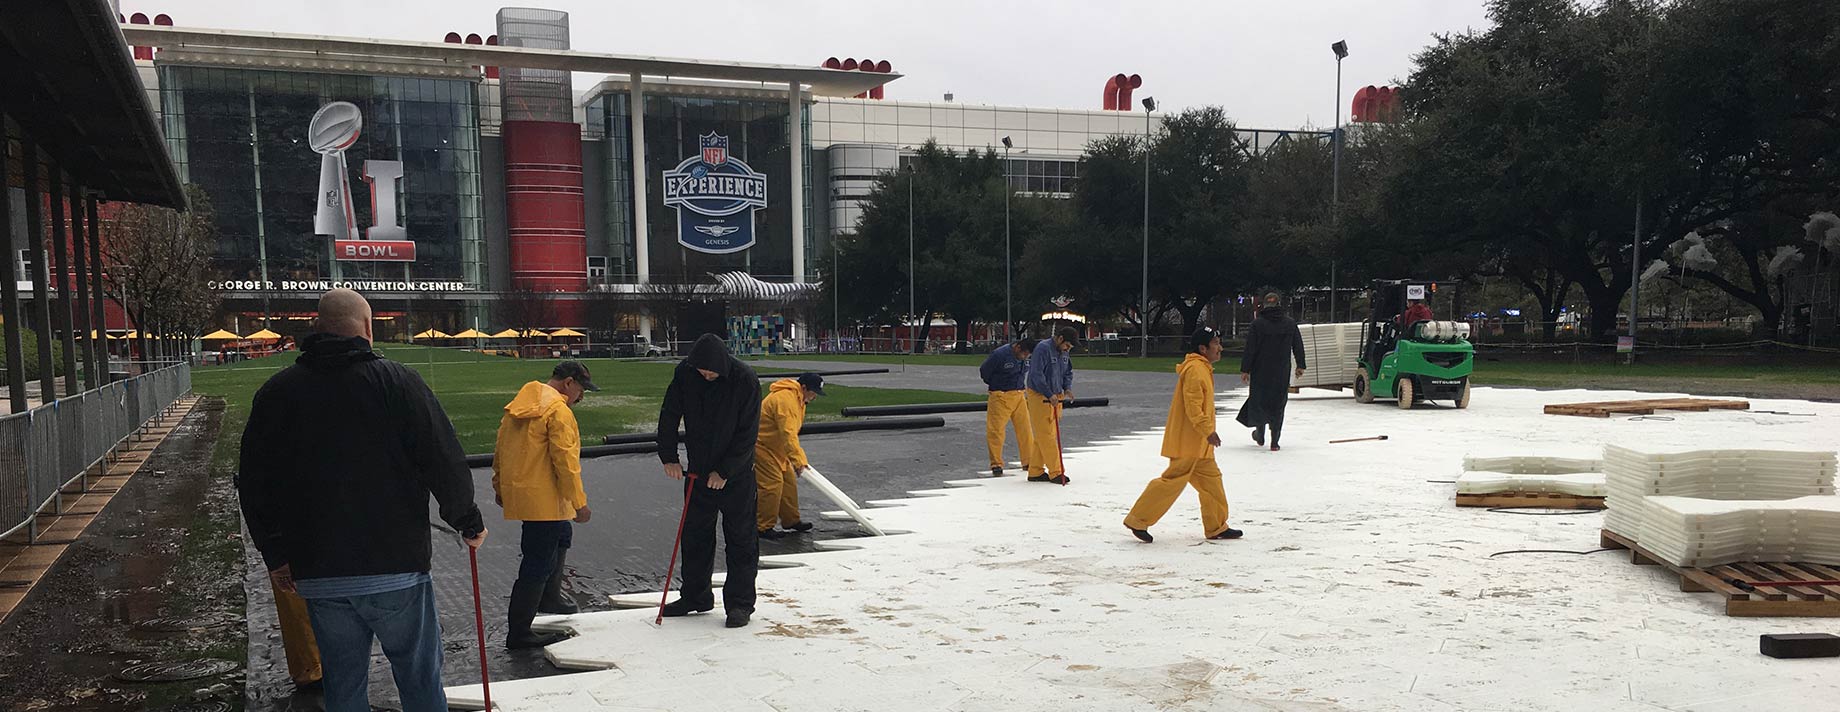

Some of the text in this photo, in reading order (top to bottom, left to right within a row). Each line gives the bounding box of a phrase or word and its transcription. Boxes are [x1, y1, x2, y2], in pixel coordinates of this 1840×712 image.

[703, 148, 726, 164] NFL
[667, 177, 763, 198] EXPERIENCE
[345, 245, 398, 257] BOWL
[207, 280, 464, 291] GEORGE R. BROWN CONVENTION CENTER
